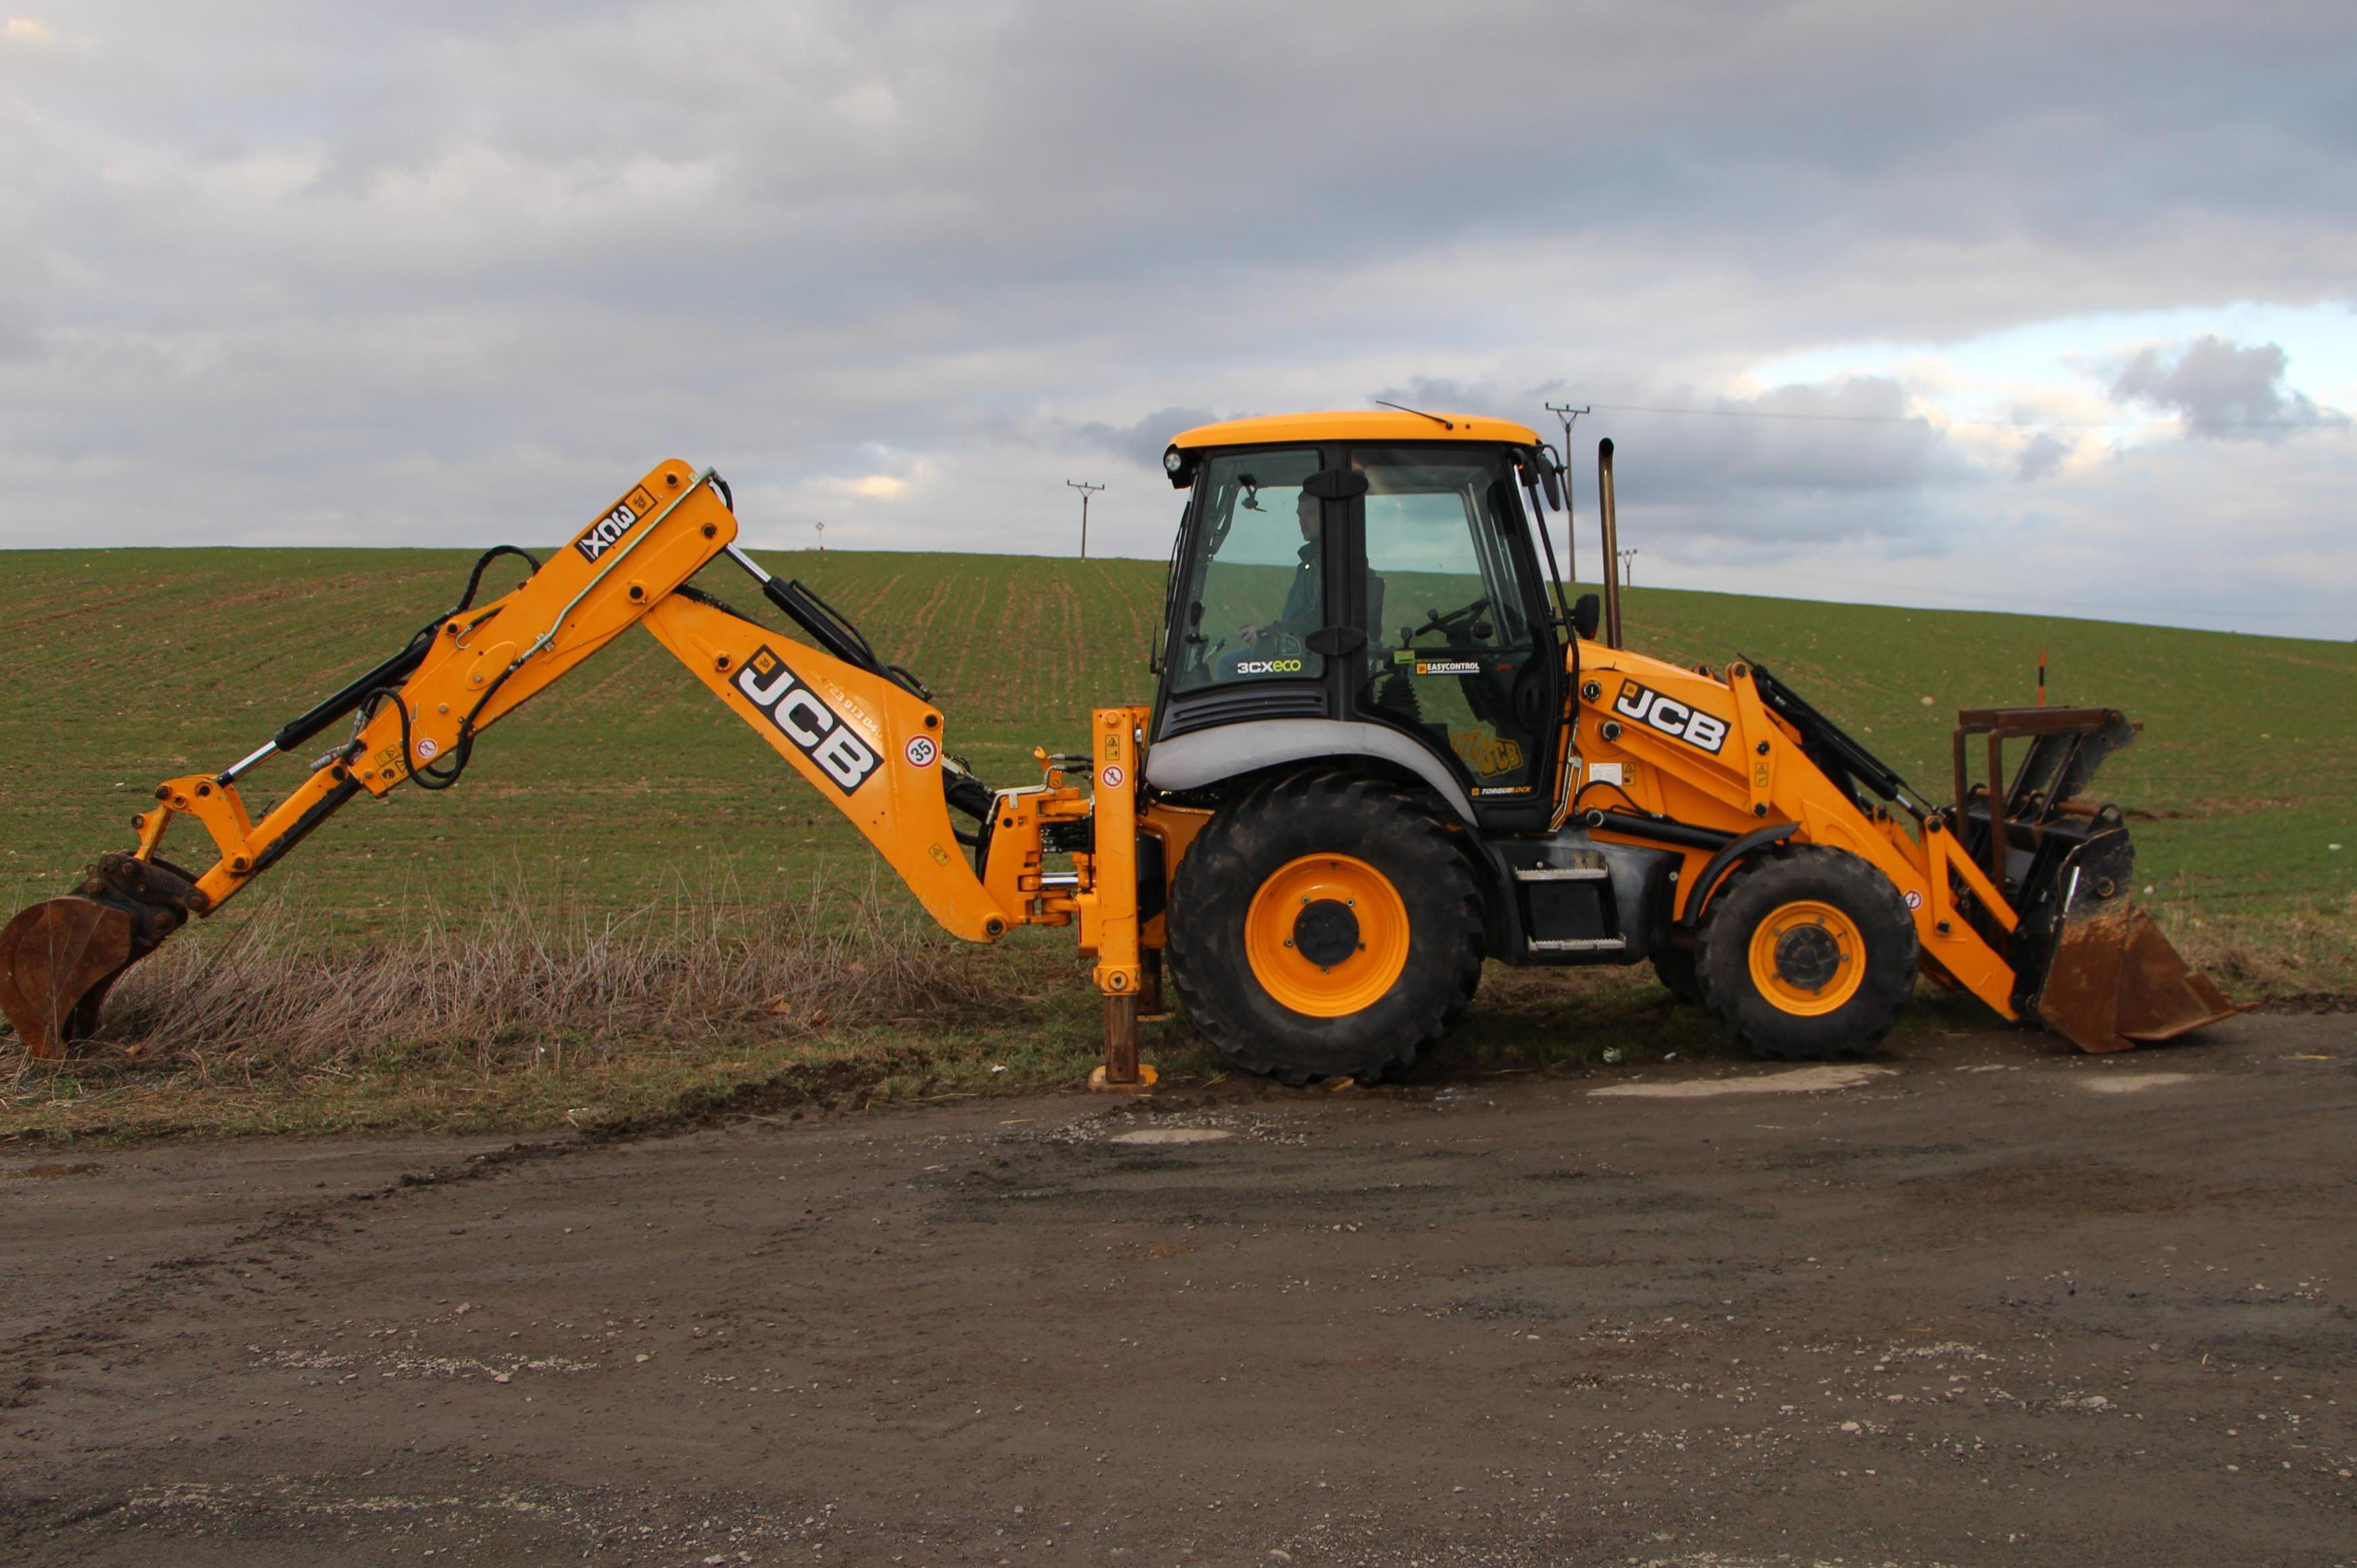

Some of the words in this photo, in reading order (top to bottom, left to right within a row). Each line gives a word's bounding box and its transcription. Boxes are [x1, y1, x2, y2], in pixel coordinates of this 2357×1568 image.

[580, 505, 636, 558] 3CX
[1237, 659, 1302, 674] 3CXeco
[1427, 661, 1480, 672] EASYCONTROL
[843, 699, 865, 720] 913
[1617, 689, 1726, 751] JCB
[739, 667, 874, 788] JCB
[910, 740, 932, 762] 35
[1480, 739, 1521, 773] JCB
[1481, 786, 1532, 794] TORQUELOCK
